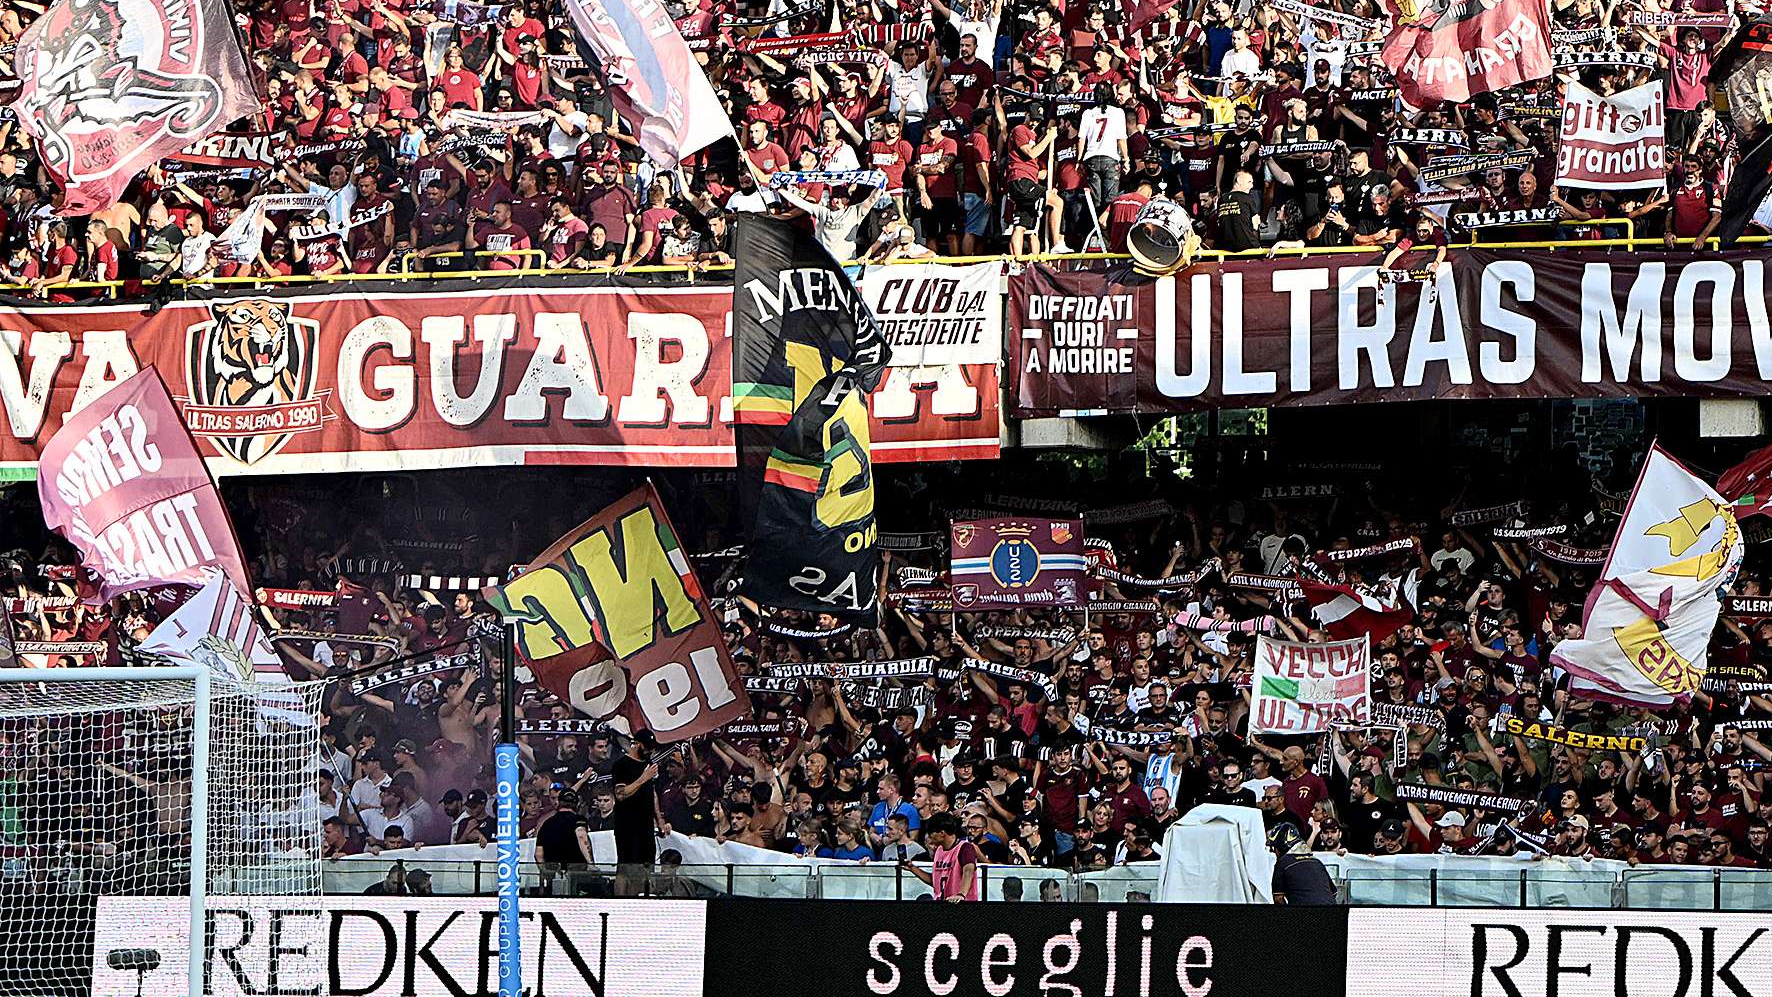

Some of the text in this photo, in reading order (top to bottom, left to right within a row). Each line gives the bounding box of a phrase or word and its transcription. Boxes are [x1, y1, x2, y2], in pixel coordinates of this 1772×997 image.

[1634, 12, 1677, 24] RIBERY
[1350, 90, 1387, 101] MACTE
[1096, 117, 1108, 142] 7
[1557, 139, 1665, 178] granata
[876, 278, 986, 315] CLUB DAL
[1029, 294, 1133, 322] DIFFIDATI
[1054, 323, 1103, 347] DURI
[1155, 260, 1537, 398] ULTRAS
[1025, 348, 1133, 374] A MORIRE
[187, 406, 318, 431] ULTRAS SALERNO 1990
[1329, 547, 1368, 561] TEDDY
[351, 649, 470, 693] SALERNO
[772, 657, 930, 680] NUOVA GUARDIA
[1507, 718, 1647, 752] SALERNO
[1429, 789, 1479, 806] MOVEMENT
[1480, 794, 1521, 812] SALERNO
[203, 909, 608, 997] REDKEN
[866, 910, 1215, 997] sceglie
